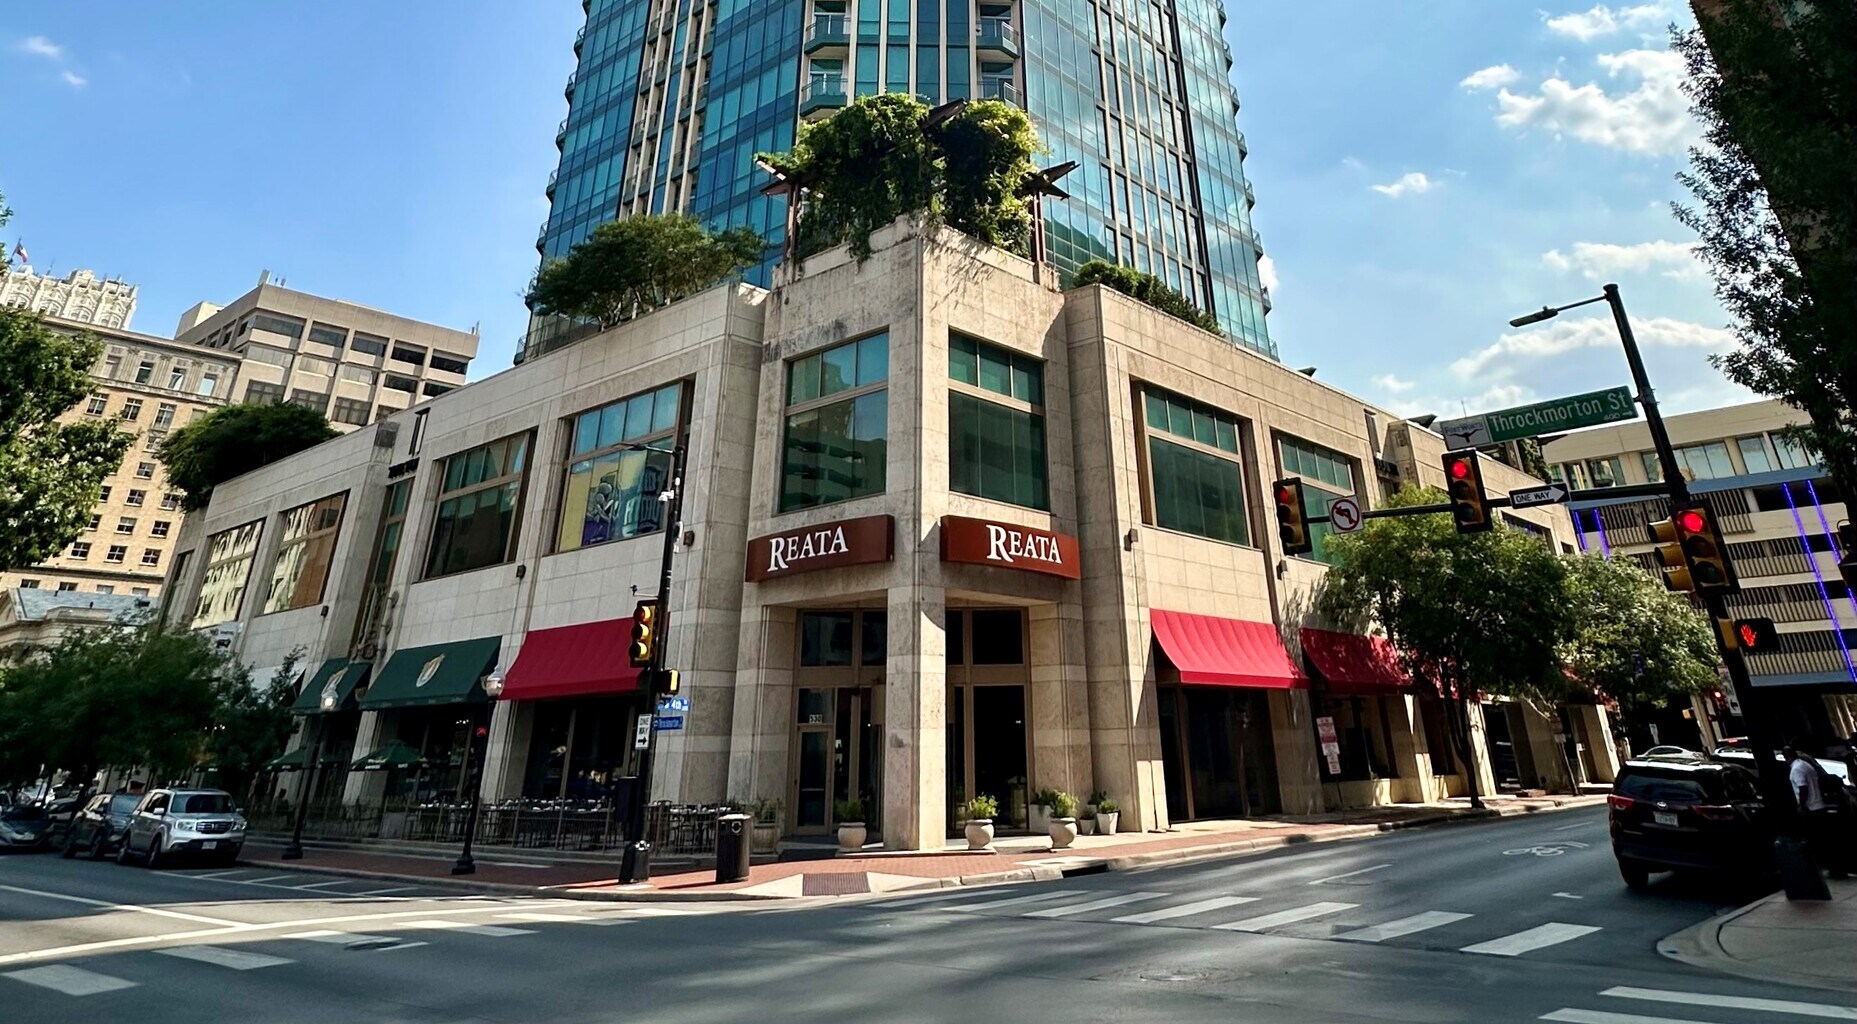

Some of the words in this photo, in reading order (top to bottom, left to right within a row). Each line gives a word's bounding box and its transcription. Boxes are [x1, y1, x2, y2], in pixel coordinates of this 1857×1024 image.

[1489, 399, 1602, 432] Throckmorton
[1607, 392, 1629, 410] St
[1515, 492, 1531, 503] ONE
[1534, 490, 1551, 500] WAY
[767, 526, 849, 572] REATA
[986, 524, 1062, 564] REATA
[638, 727, 648, 735] WAY
[639, 717, 649, 726] ONE
